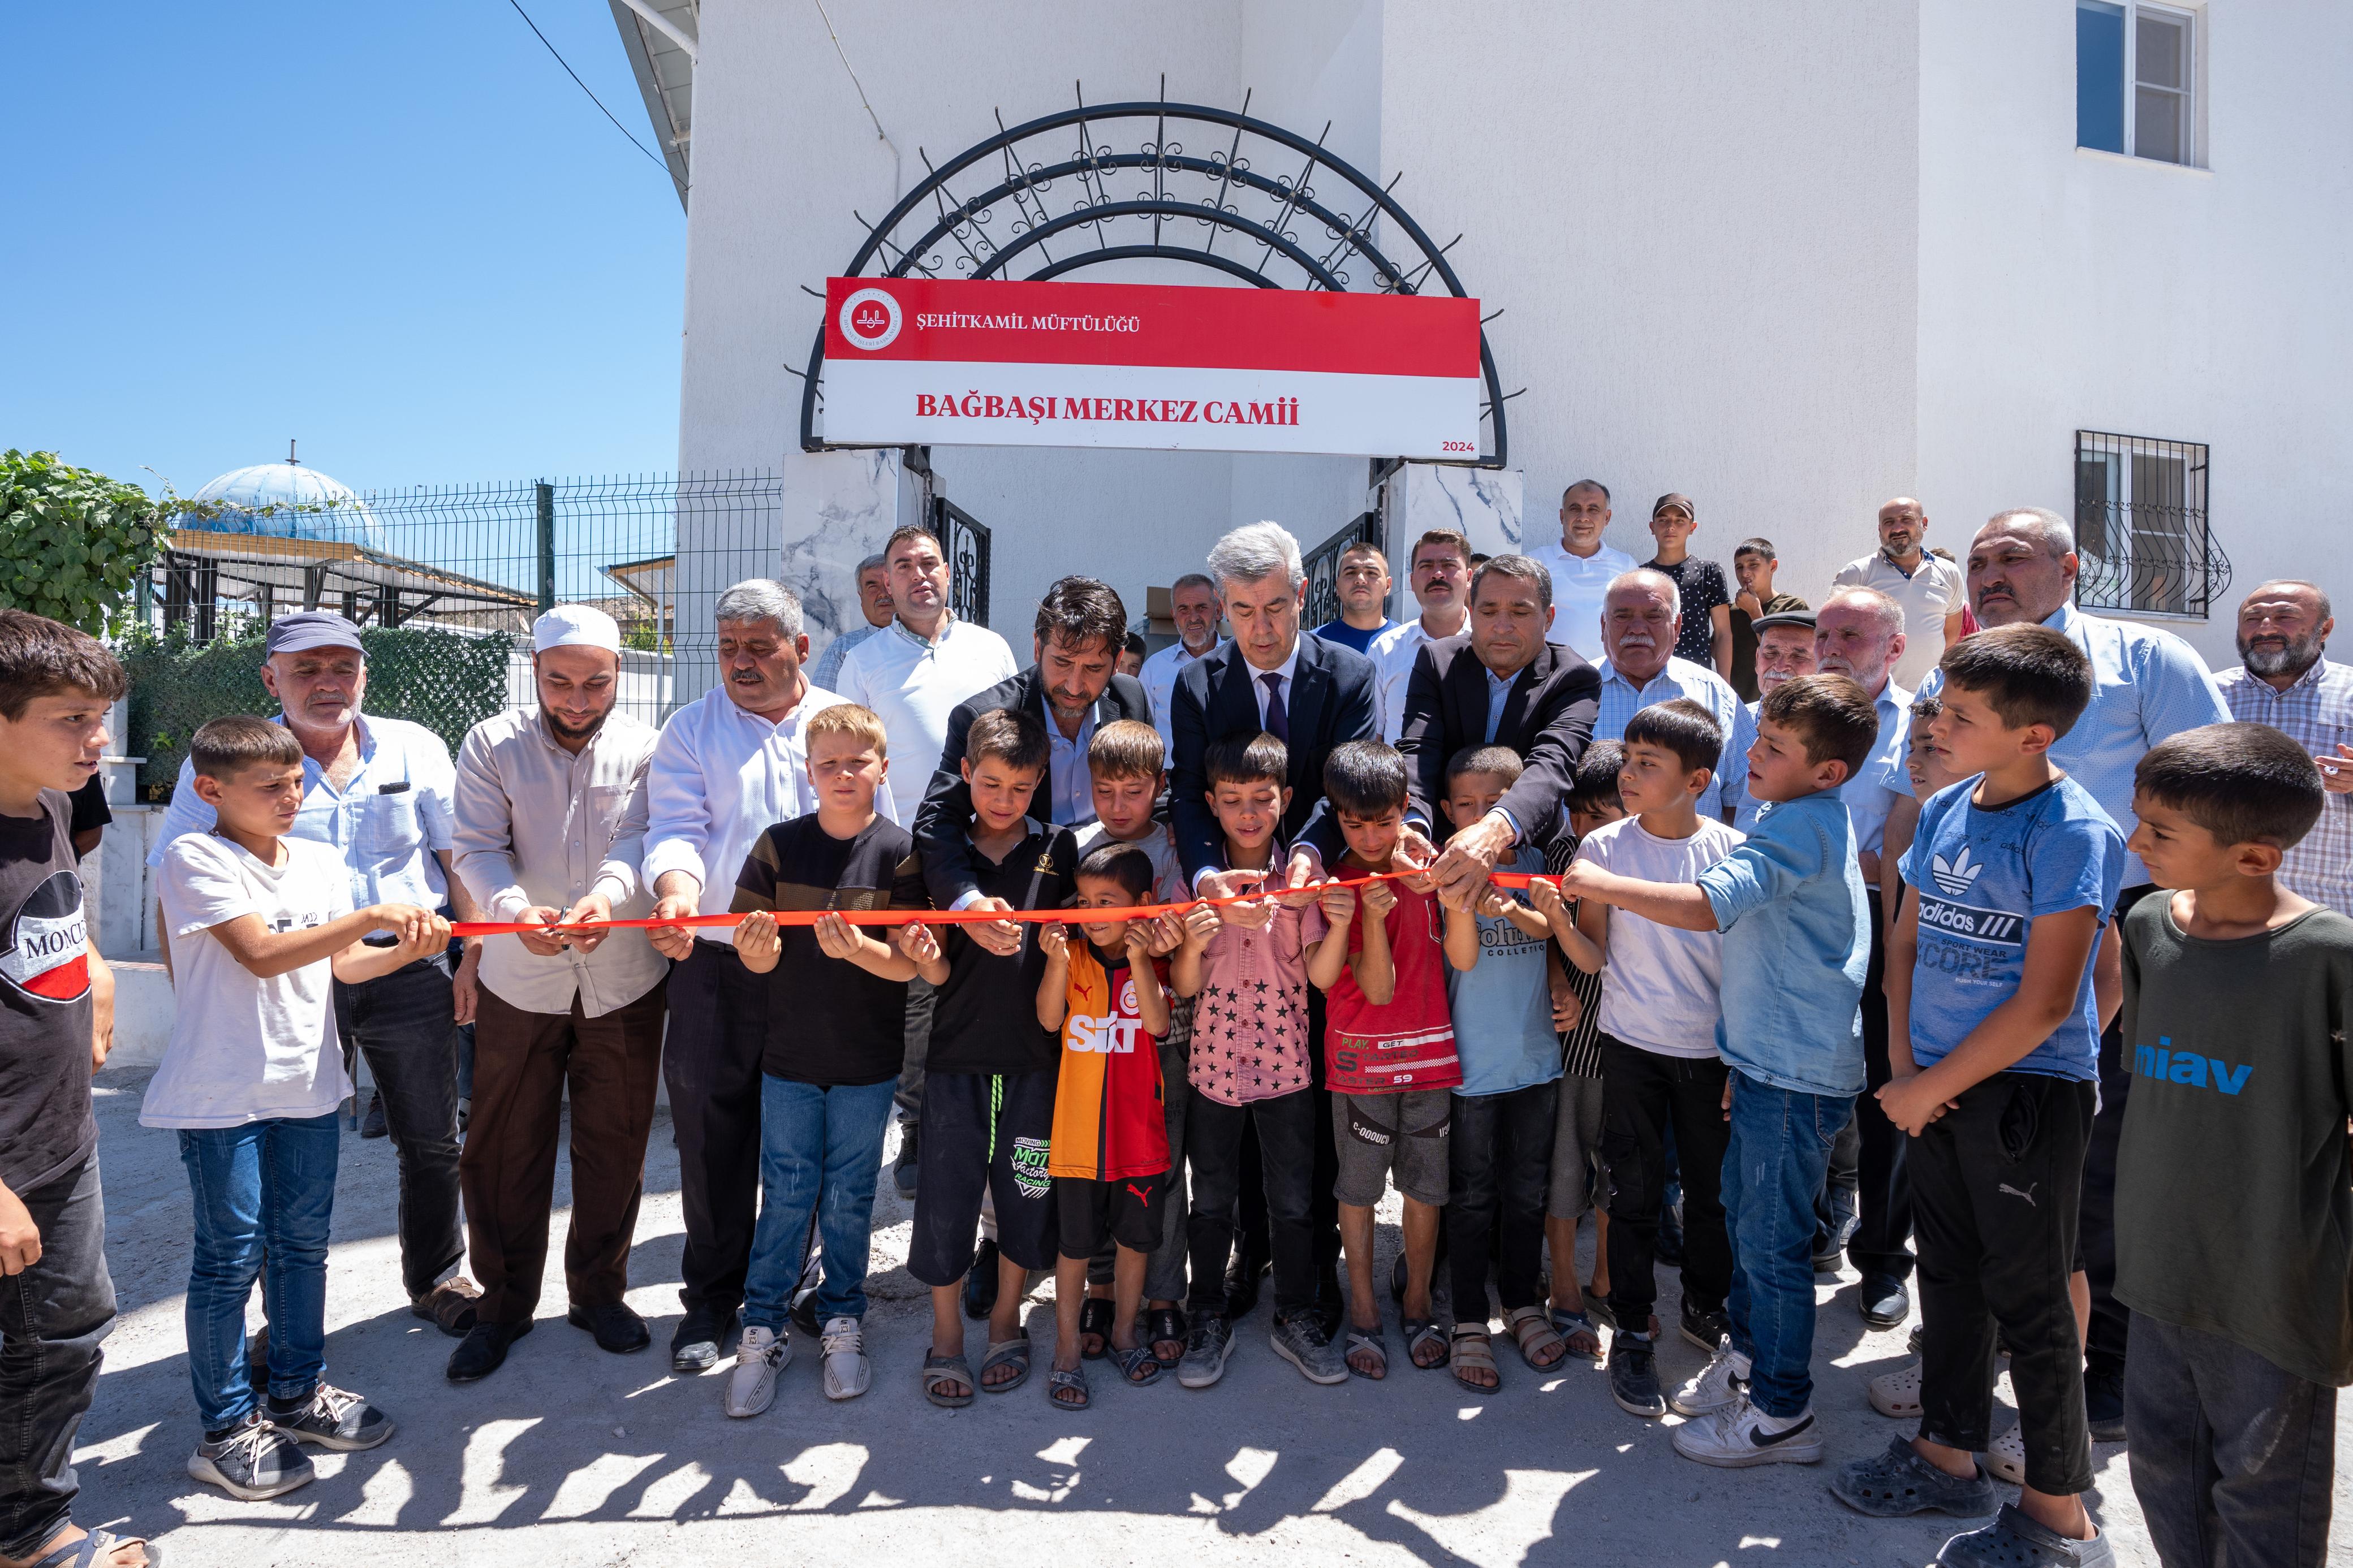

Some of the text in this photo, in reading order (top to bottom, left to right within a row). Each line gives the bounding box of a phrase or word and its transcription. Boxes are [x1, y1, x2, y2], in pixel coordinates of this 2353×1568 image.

[916, 312, 1140, 332] ŞEHİTKAMİL MÜFTÜLÜĞÜ
[916, 390, 1299, 426] BAĞBAŞI MERKEZ CAMİİ
[1442, 442, 1475, 452] 2024
[1941, 939, 2007, 958] SPORT WEAR
[1393, 1074, 1413, 1084] 59
[1016, 1138, 1041, 1146] MOVING
[1014, 1147, 1050, 1167] MOT
[1015, 1173, 1051, 1187] RACING
